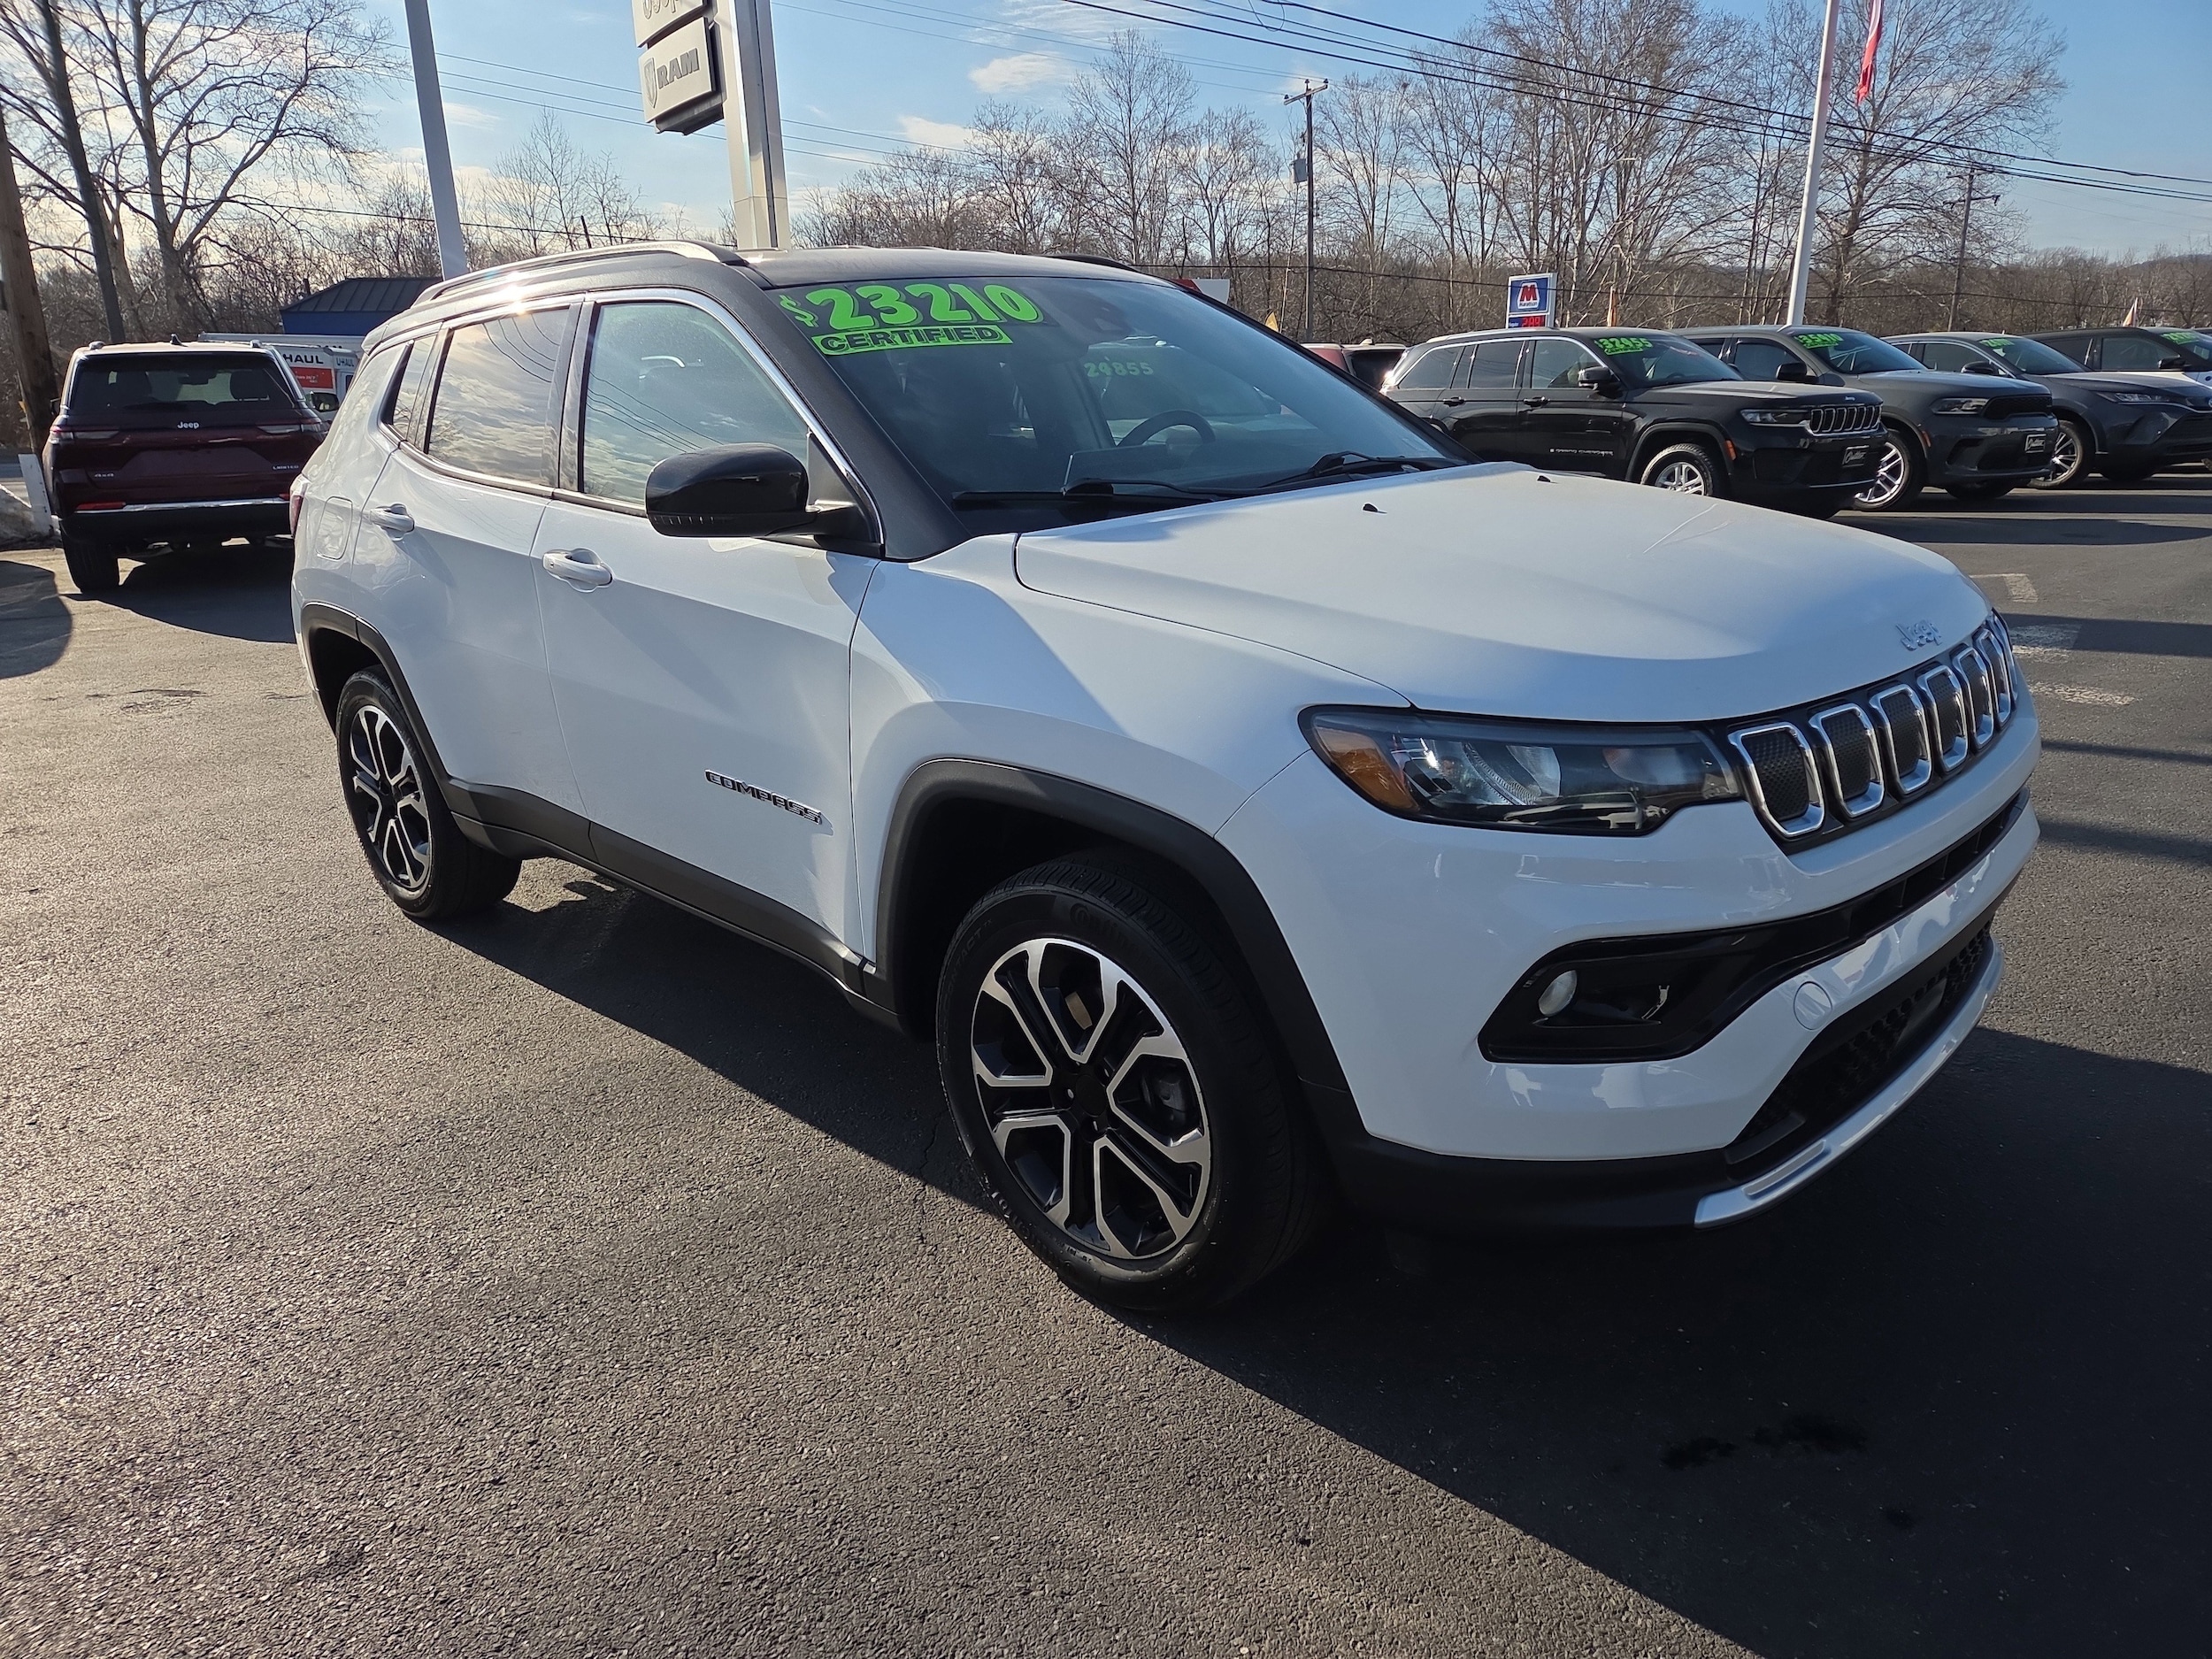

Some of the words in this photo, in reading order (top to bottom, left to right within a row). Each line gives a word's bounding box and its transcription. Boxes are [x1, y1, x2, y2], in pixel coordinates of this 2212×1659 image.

[657, 48, 700, 89] RAM
[780, 283, 1044, 331] $23210
[820, 326, 1003, 352] CERTIFIED
[283, 353, 324, 365] HAUL
[177, 421, 200, 430] Jeep
[1895, 620, 1943, 652] Jeep
[704, 769, 823, 826] COMPASS
